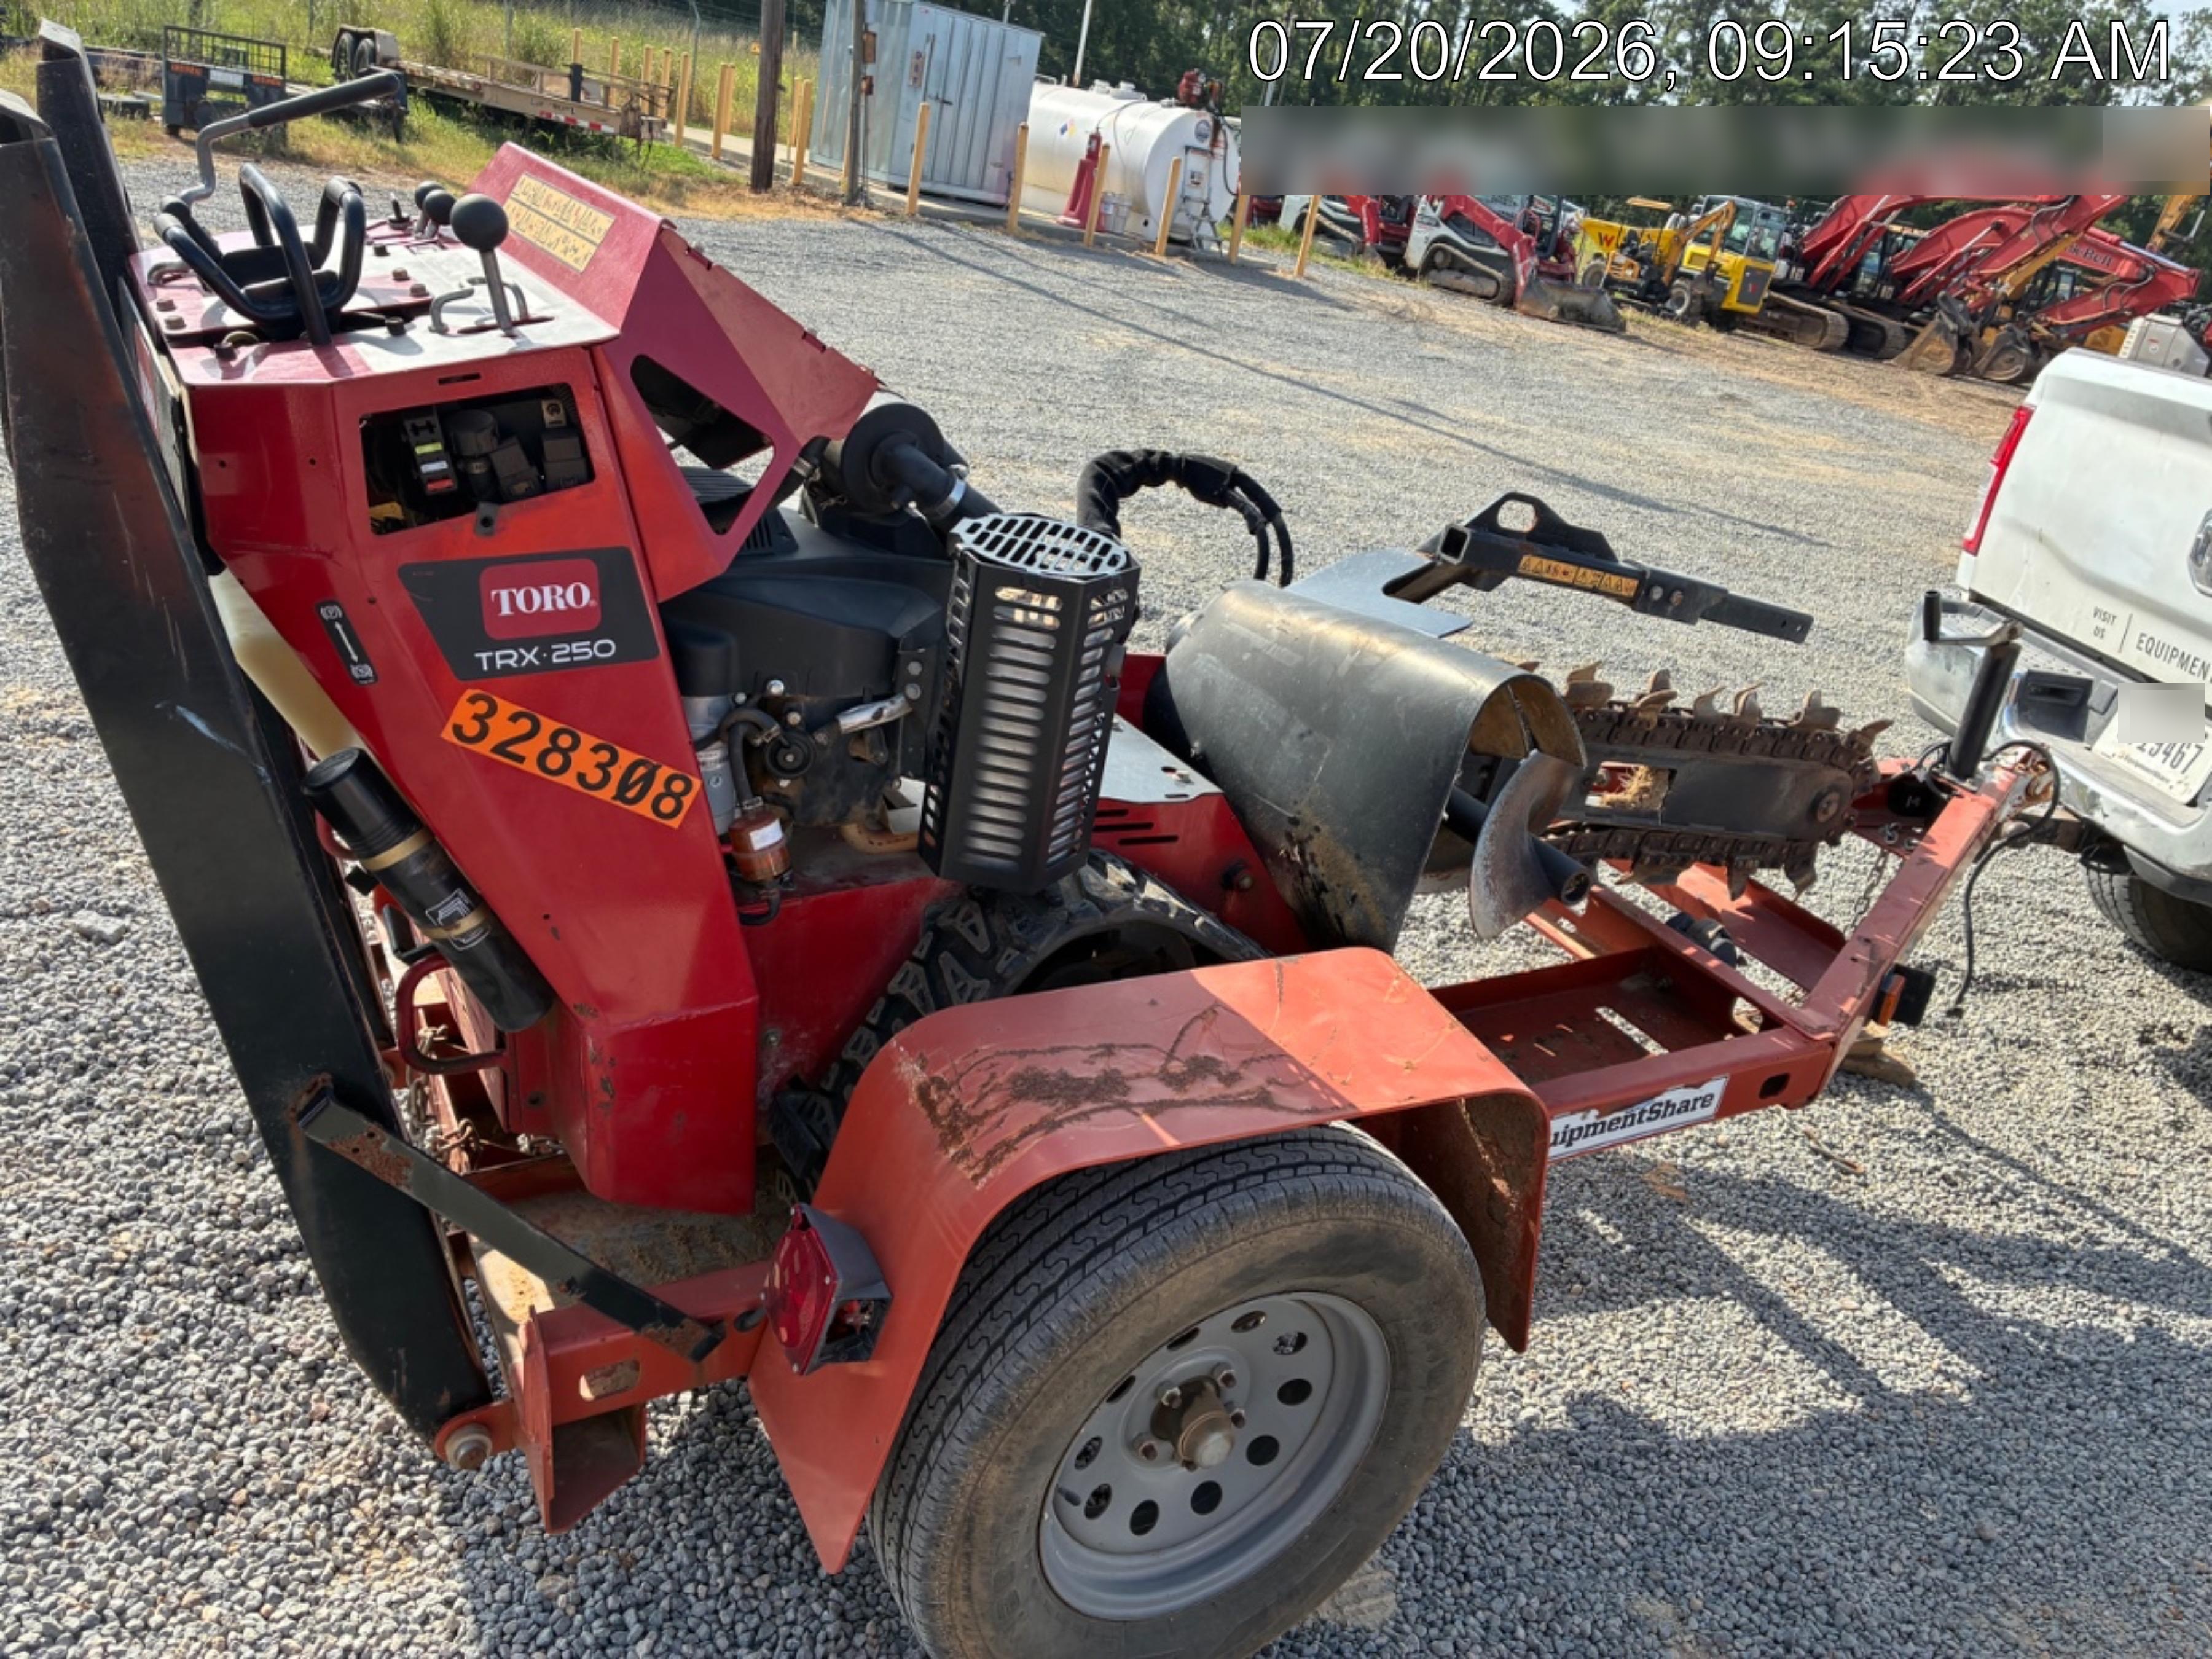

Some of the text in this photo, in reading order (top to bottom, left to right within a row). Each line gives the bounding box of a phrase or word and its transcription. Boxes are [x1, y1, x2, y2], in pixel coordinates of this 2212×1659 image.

[492, 582, 592, 616] TORO
[2093, 606, 2117, 625] VISIT
[2093, 626, 2106, 639] US
[2136, 632, 2212, 683] EQUIPMEN
[452, 693, 694, 820] 328308
[1550, 1092, 1715, 1147] uipmentShare
